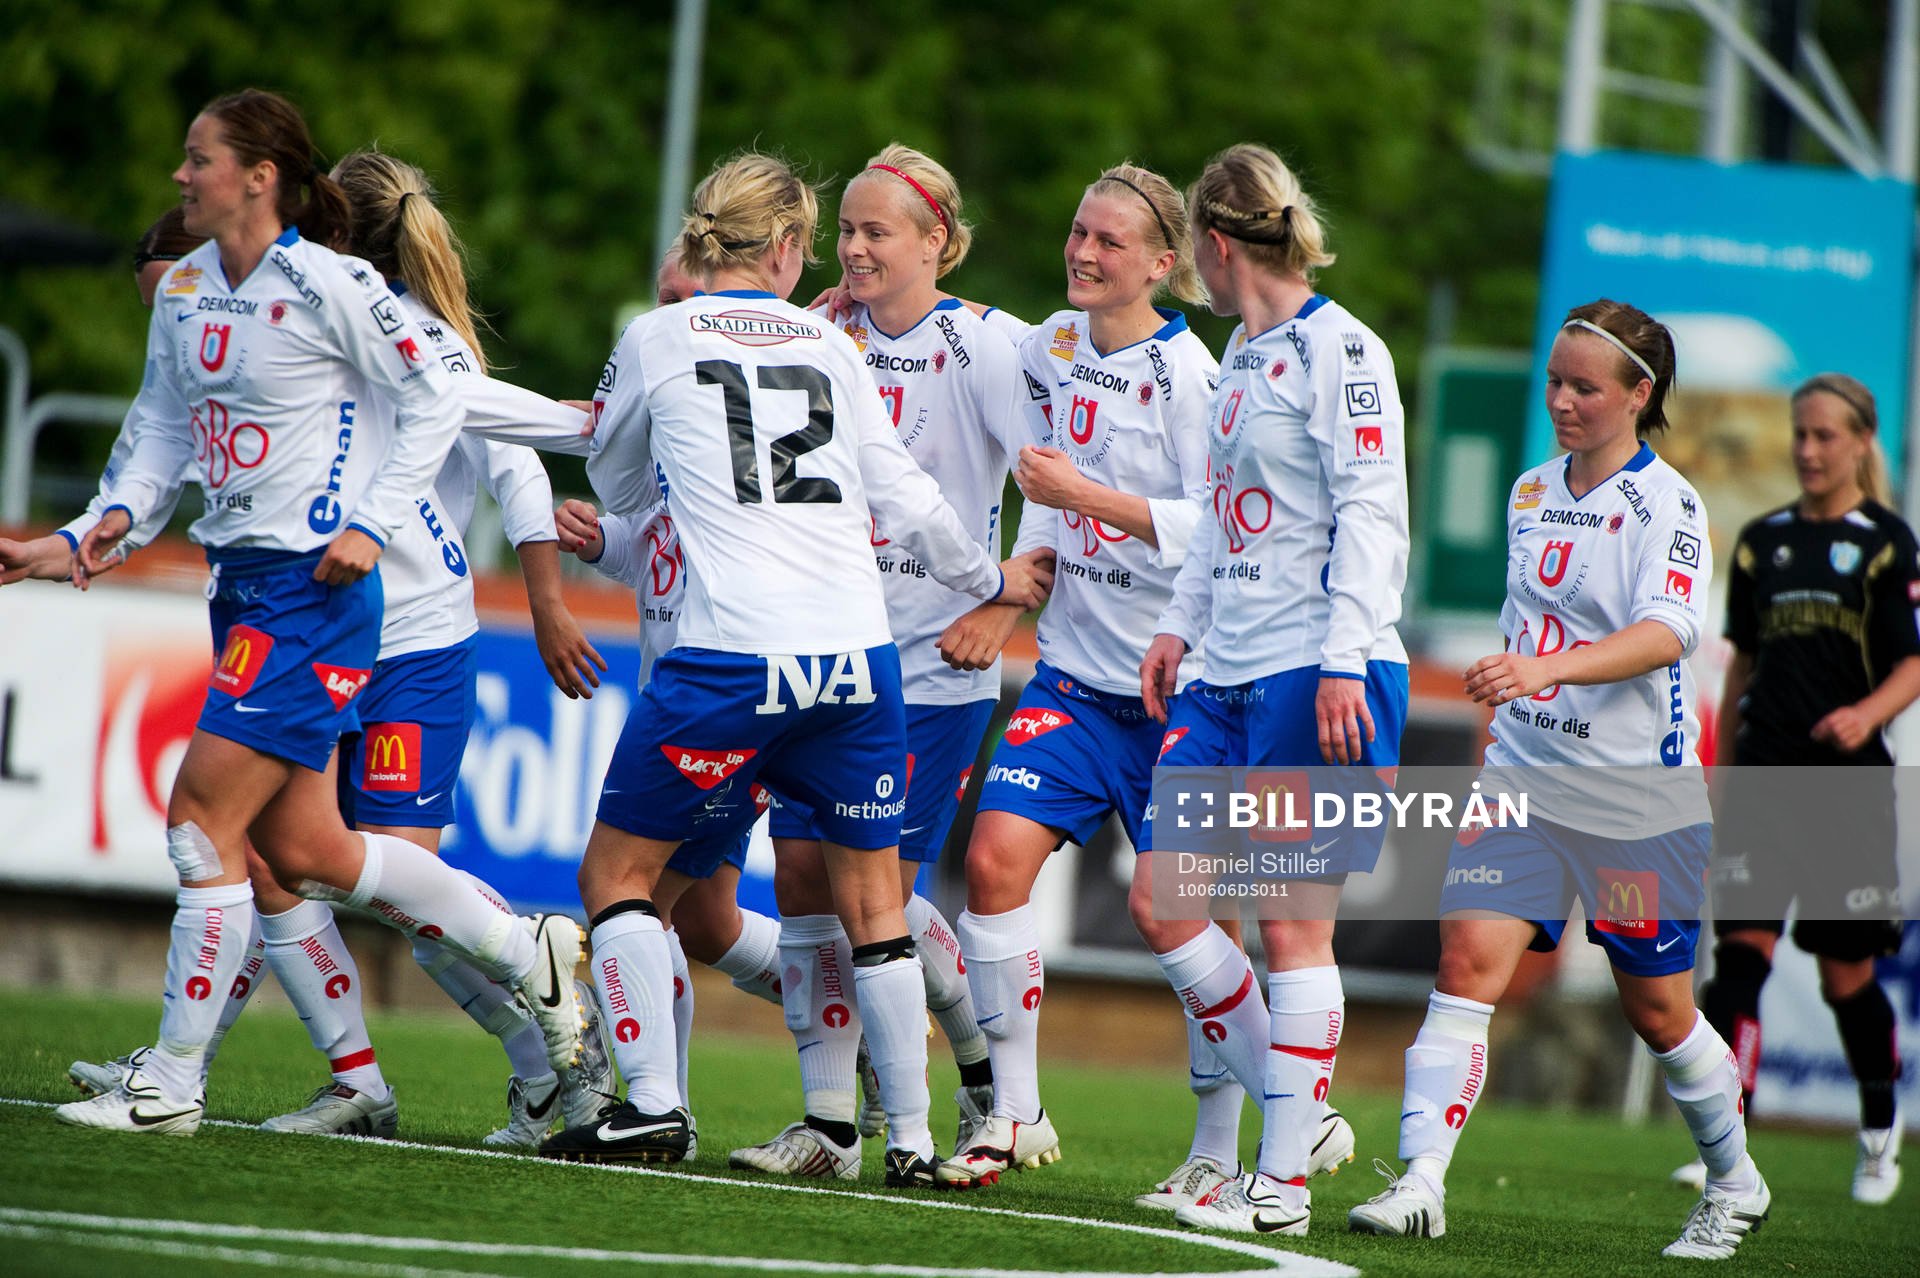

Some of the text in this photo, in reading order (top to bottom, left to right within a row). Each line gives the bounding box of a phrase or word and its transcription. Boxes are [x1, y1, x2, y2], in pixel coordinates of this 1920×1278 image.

[271, 251, 323, 310] stadium
[197, 296, 258, 317] DEMCOM
[700, 313, 819, 338] SKADETEKNIK
[935, 315, 971, 369] stadium
[1071, 363, 1130, 394] DEMCOM
[696, 359, 842, 504] 12
[226, 494, 252, 511] dig
[1541, 509, 1604, 529] DEMCOM
[900, 559, 926, 578] dig
[1061, 556, 1131, 588] Hem för dig
[659, 605, 673, 622] för
[1651, 595, 1683, 609] SVENSKA
[755, 650, 877, 715] NA
[1041, 712, 1060, 727] UP
[1510, 700, 1590, 739] Hem för dig
[678, 752, 744, 777] BACK UP
[197, 907, 223, 972] COMFORT
[602, 956, 630, 1015] COMFORT
[816, 941, 844, 1001] COMFORT
[1459, 1043, 1486, 1104] COMFORT
